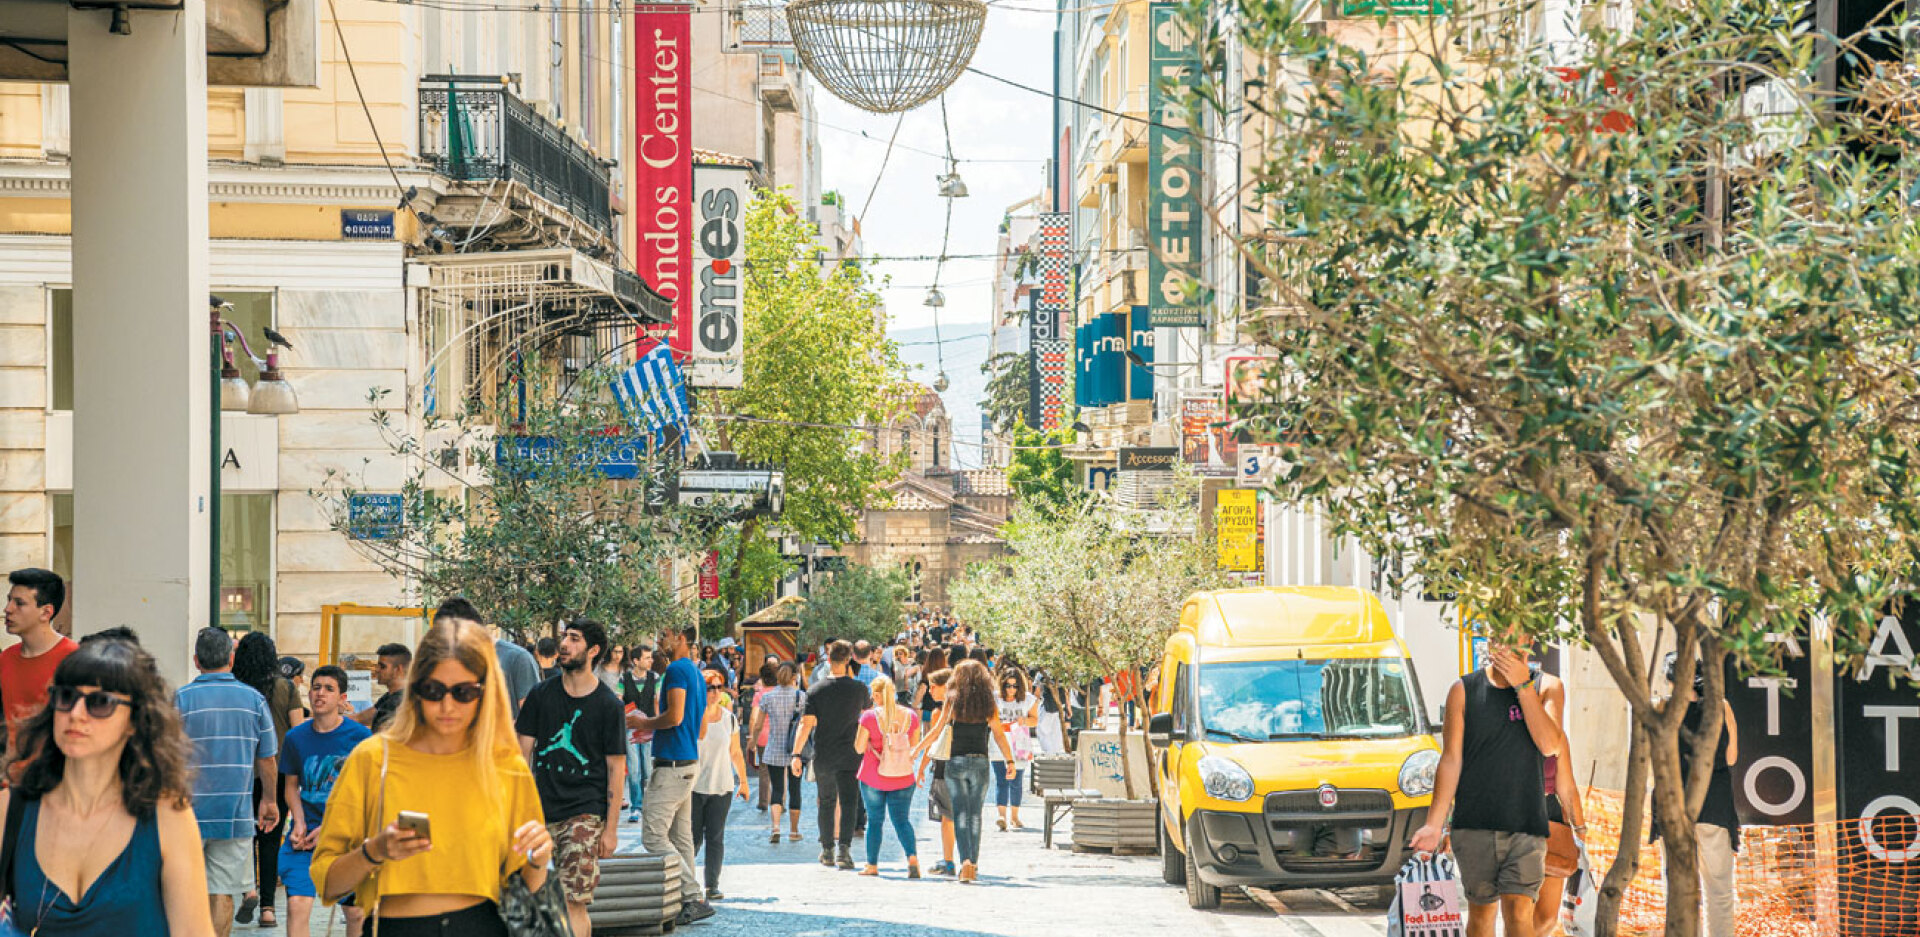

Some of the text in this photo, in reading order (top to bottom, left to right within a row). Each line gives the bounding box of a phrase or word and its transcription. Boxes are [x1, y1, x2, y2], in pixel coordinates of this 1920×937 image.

[641, 29, 679, 168] Center
[1244, 456, 1260, 475] 3
[1222, 505, 1252, 515] ΑΓΟΡΑ
[1405, 911, 1460, 924] Foot Locker
